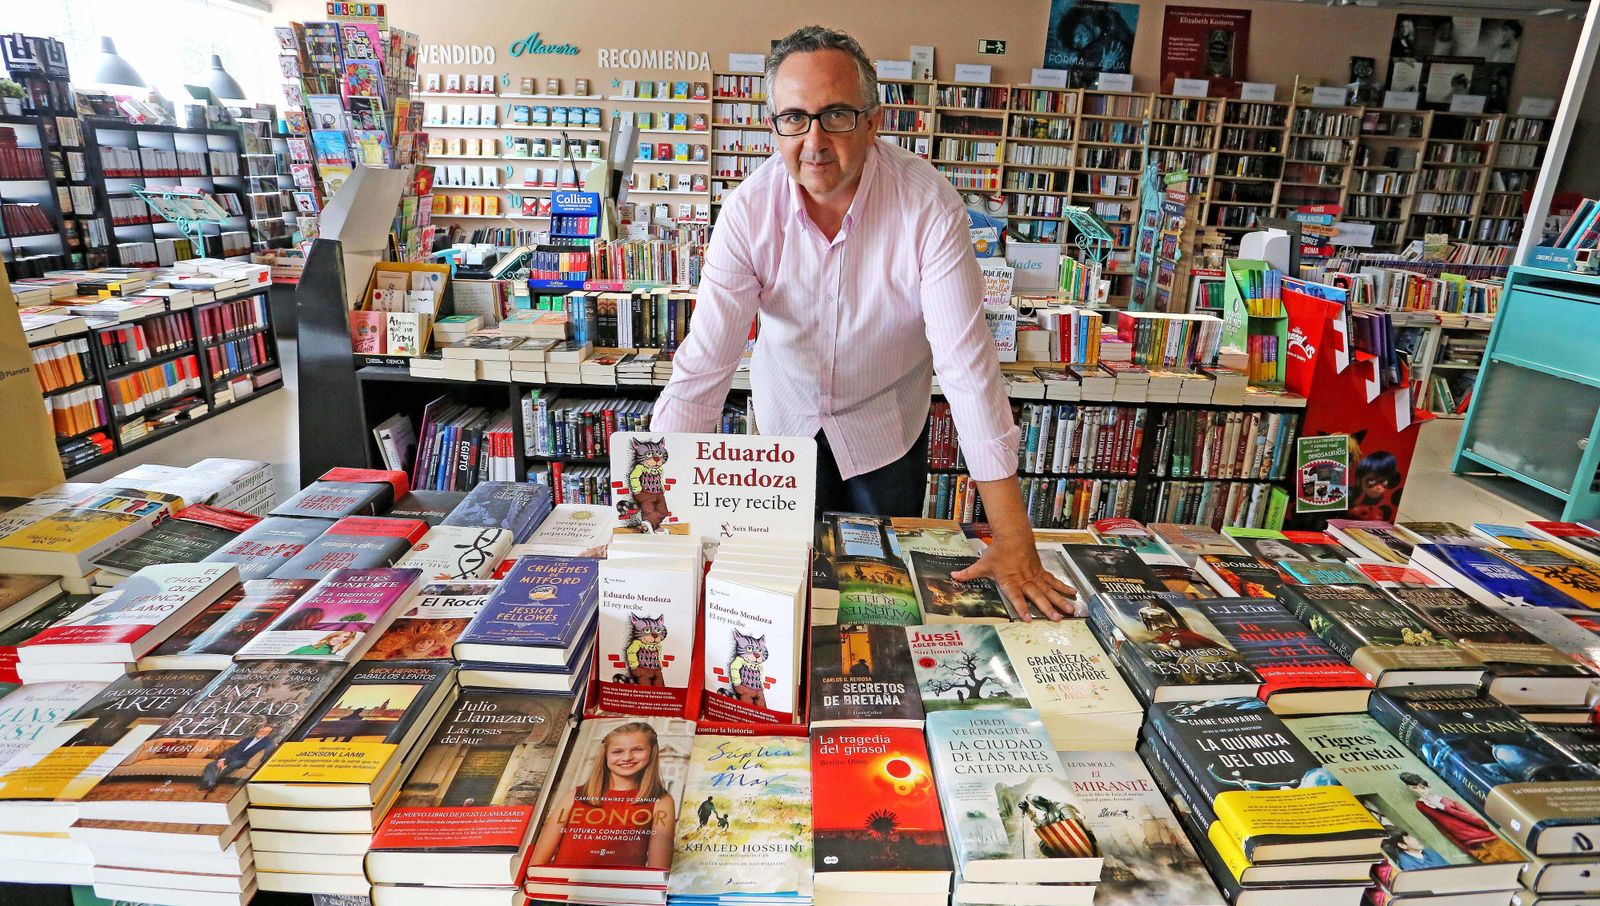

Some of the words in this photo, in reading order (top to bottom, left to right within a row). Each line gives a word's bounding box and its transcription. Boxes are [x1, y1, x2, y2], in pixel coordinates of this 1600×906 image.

[508, 32, 581, 62] Alavera
[418, 43, 496, 70] VENDIDO
[1048, 54, 1085, 66] FORMA
[597, 52, 711, 76] RECOMIENDA
[556, 194, 593, 205] Collins
[1303, 247, 1319, 255] ROMA
[6, 369, 31, 379] Planeta
[458, 439, 472, 472] EGIPTO
[694, 441, 795, 464] Eduardo
[692, 466, 798, 490] Mendoza
[692, 492, 710, 508] El
[715, 495, 742, 513] rey
[745, 495, 797, 511] recibe
[732, 525, 748, 534] Seix
[748, 525, 770, 534] Barral
[526, 564, 590, 575] CRÍMENES
[162, 576, 212, 584] CHICO
[322, 581, 400, 589] MONFORTE
[519, 576, 582, 586] MITFORD
[168, 585, 202, 593] QUE
[1104, 582, 1144, 592] MUERTE
[420, 597, 441, 608] El
[445, 597, 488, 608] Rocío
[603, 591, 636, 602] Eduardo
[636, 593, 672, 604] Mendoza
[510, 606, 555, 616] JESSICA
[603, 601, 612, 610] El
[612, 602, 623, 612] rey
[623, 603, 644, 612] recibe
[1241, 604, 1278, 614] Finn
[496, 613, 559, 625] FELLOWES
[709, 602, 740, 616] Eduardo
[740, 607, 773, 625] Mendoza
[718, 614, 729, 625] rey
[729, 616, 747, 628] recibe
[910, 630, 962, 643] Jussi
[1239, 627, 1307, 644] mujer
[1151, 647, 1228, 658] ENEMIGOS
[1027, 654, 1089, 667] GRANDEZA
[367, 667, 395, 675] MICK
[395, 667, 431, 675] HERRON
[1045, 665, 1060, 673] LAS
[1059, 663, 1095, 673] COSAS
[1155, 661, 1249, 675] ESPARTA
[158, 673, 206, 682] SHAPIRO
[353, 673, 399, 681] CABALLOS
[401, 673, 437, 681] LENTOS
[1034, 673, 1056, 684] SIN
[1059, 670, 1110, 682] NOMBRE
[103, 687, 202, 698] FALSIFICADORA
[204, 685, 265, 698] UNA
[842, 683, 905, 694] SECRETOS
[105, 697, 180, 712] ARTE
[823, 696, 840, 707] DE
[843, 693, 901, 706] BRETAÑA
[186, 700, 300, 716] LEALTAD
[459, 701, 498, 713] Julio
[452, 712, 546, 725] Llamazares
[969, 719, 1006, 727] JORDI
[1187, 717, 1218, 727] CARME
[1219, 714, 1262, 725] CHAPARRO
[165, 718, 253, 737] REAL
[446, 726, 470, 735] Las
[472, 727, 503, 736] rosas
[697, 728, 718, 738] contar
[719, 728, 728, 737] la
[728, 728, 755, 739] historia:
[951, 727, 1030, 736] VERDAGUER
[440, 736, 462, 745] del
[462, 736, 483, 745] sur
[819, 735, 834, 745] La
[839, 735, 892, 747] tragedia
[949, 740, 971, 751] LA
[973, 738, 1043, 751] CIUDAD
[1196, 738, 1221, 752] LA
[1223, 733, 1291, 750] QUÍMICA
[1308, 734, 1377, 750] Tigres
[146, 746, 211, 758] MEMORIAS
[295, 750, 337, 758] JACKSON
[708, 741, 795, 762] Súplica
[819, 744, 839, 754] del
[844, 744, 888, 756] girasol
[952, 751, 974, 762] DE
[978, 750, 1006, 762] LAS
[1008, 749, 1049, 761] TRES
[1339, 744, 1405, 763] cristal
[819, 758, 845, 766] Benito
[847, 758, 868, 767] Olmo
[1087, 760, 1116, 768] MOLLÁ
[1218, 753, 1255, 769] DEL
[1257, 750, 1296, 766] ODIO
[954, 763, 1054, 774] CATEDRALES
[1341, 766, 1373, 775] TONI
[1374, 763, 1402, 773] HILL
[711, 773, 786, 788] Mar
[479, 810, 526, 818] LLAMAZARES
[555, 807, 669, 826] LEONOR
[594, 834, 642, 842] MONARQUÍA
[598, 828, 657, 836] CONDICIONADO
[685, 842, 739, 854] KHALED
[742, 841, 806, 854] HOSSEINI
